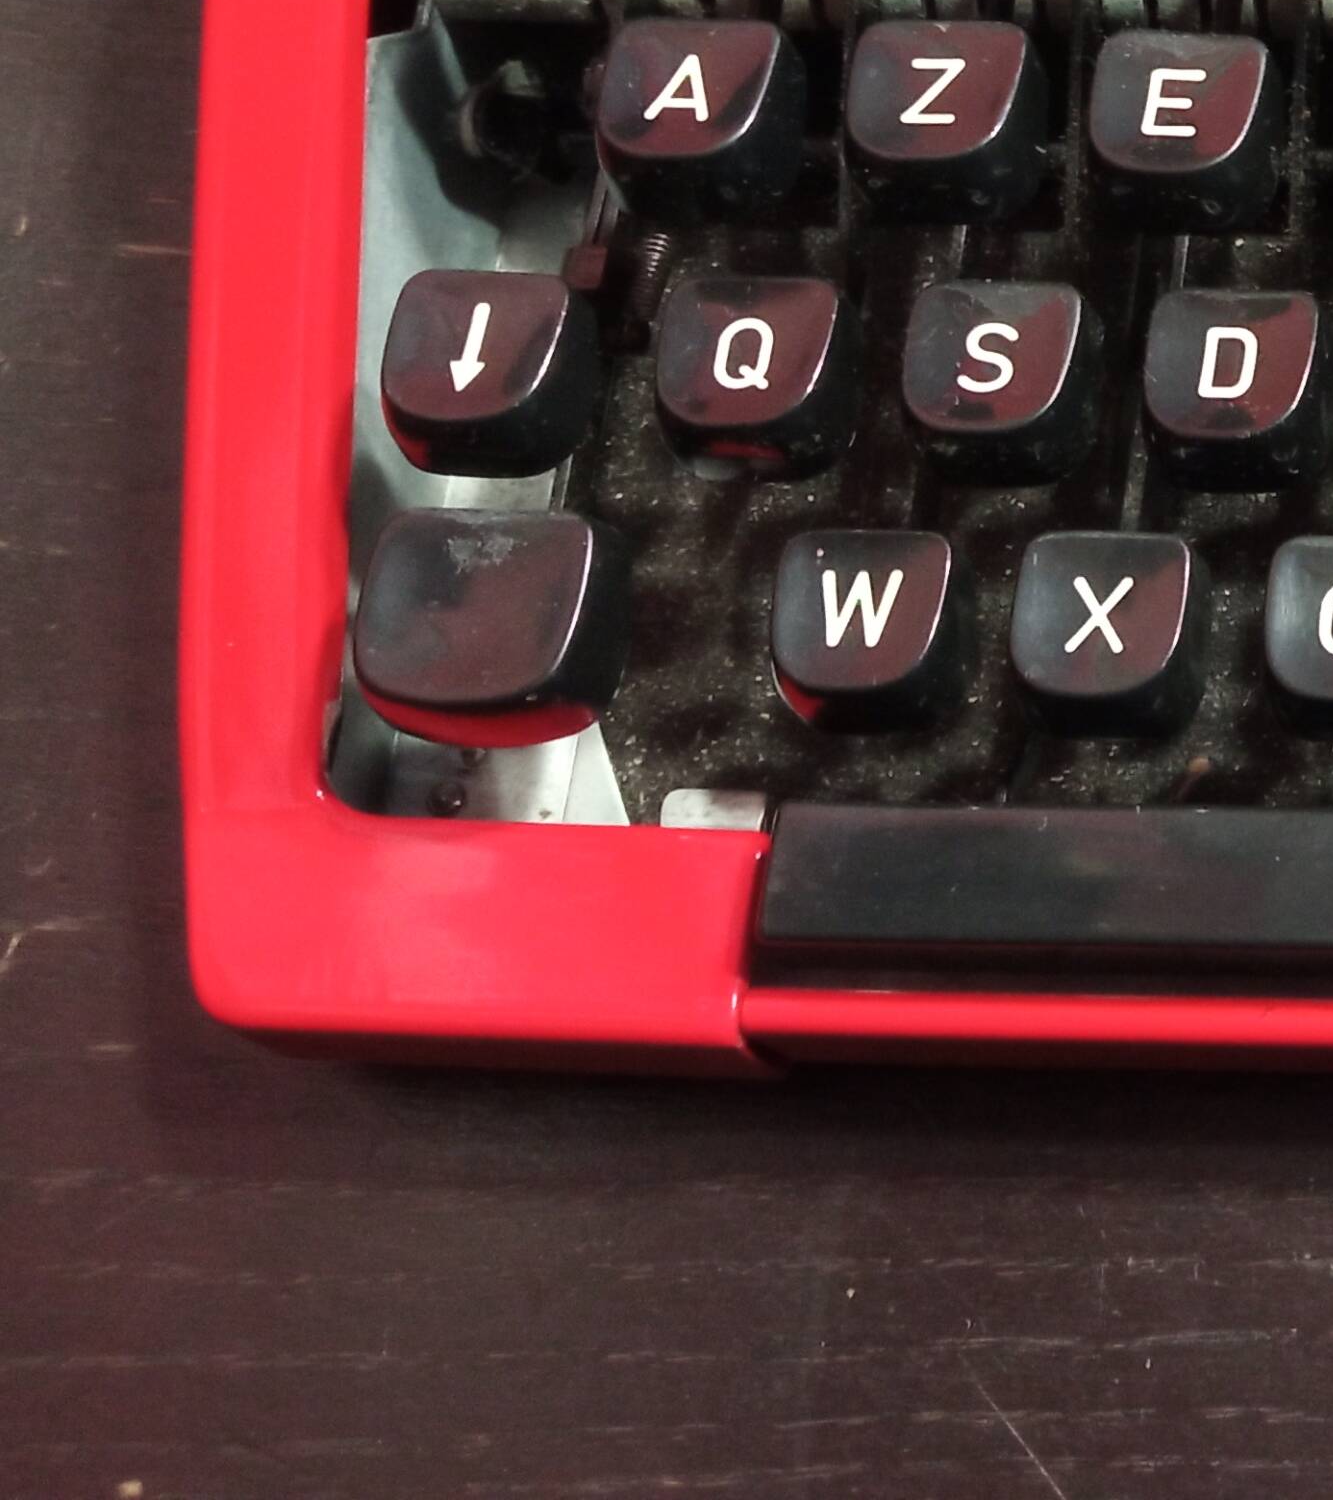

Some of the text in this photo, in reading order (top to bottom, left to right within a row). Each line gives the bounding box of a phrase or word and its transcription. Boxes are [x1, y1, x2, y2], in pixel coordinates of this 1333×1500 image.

[643, 54, 710, 122] A
[898, 58, 966, 125] Z
[1140, 68, 1207, 138] E
[713, 316, 774, 390] Q
[956, 321, 1020, 395] S
[1196, 325, 1259, 398] D
[821, 568, 904, 648] W
[1063, 575, 1135, 655] X
